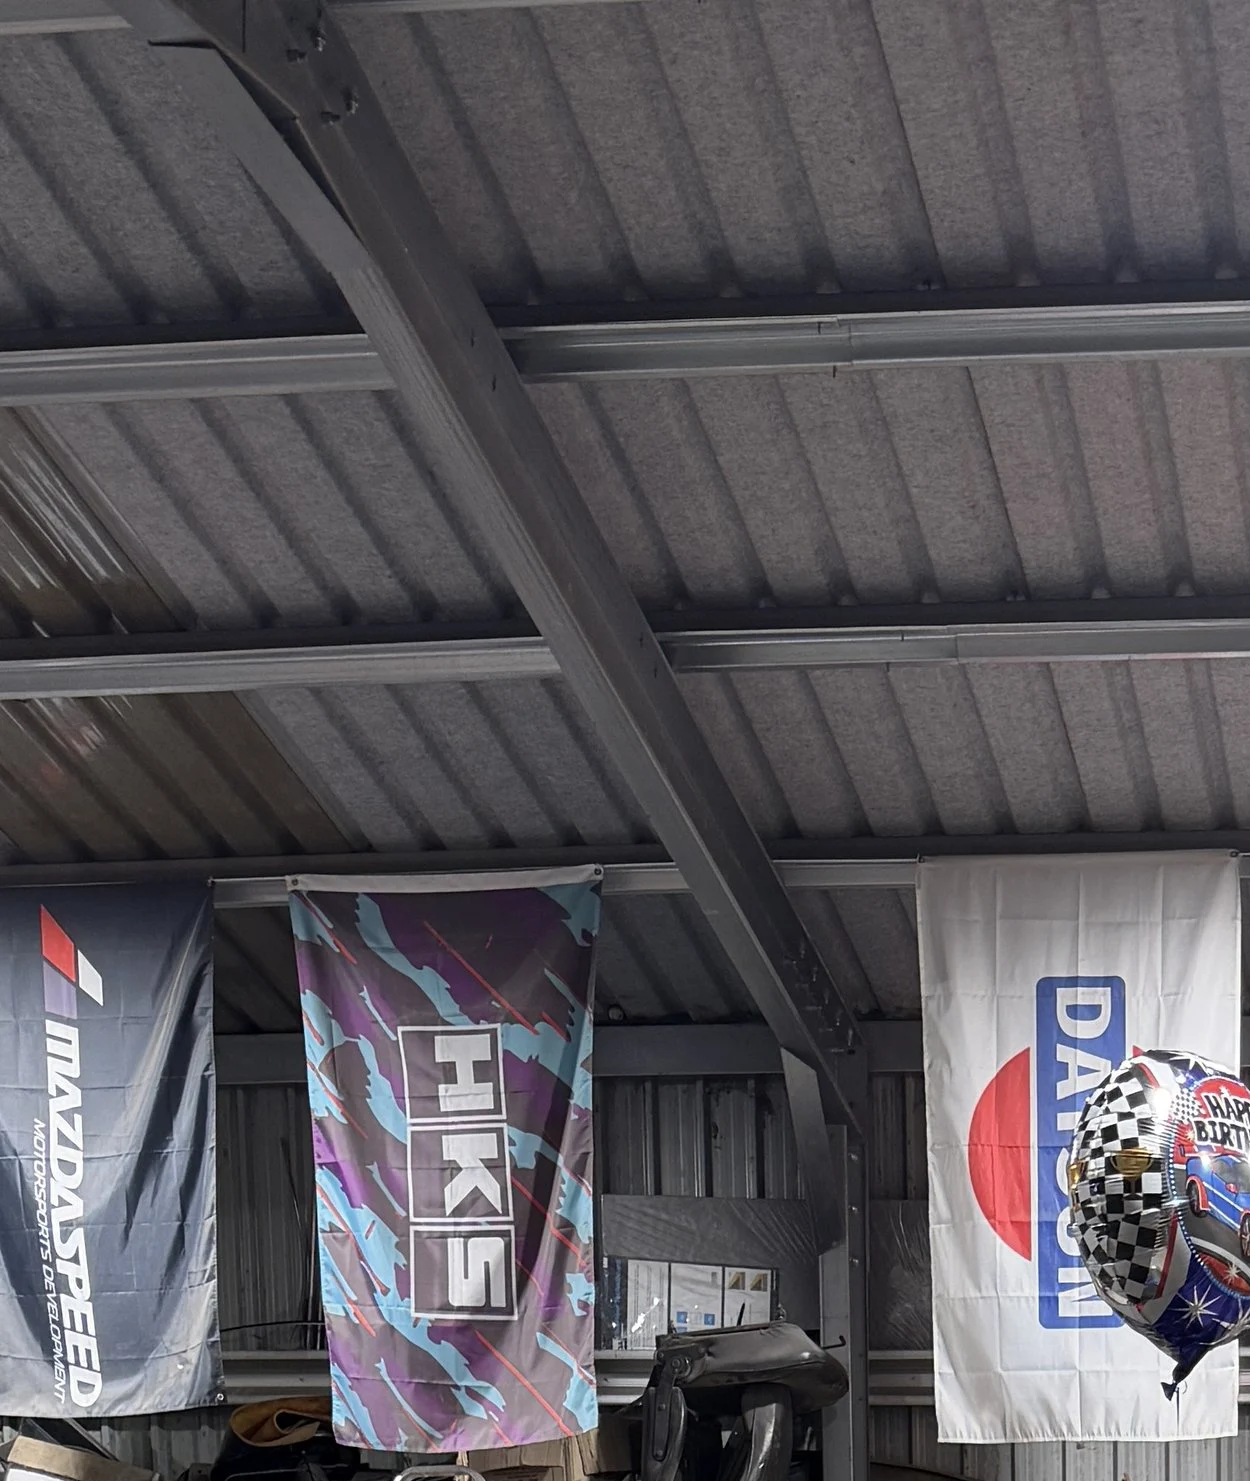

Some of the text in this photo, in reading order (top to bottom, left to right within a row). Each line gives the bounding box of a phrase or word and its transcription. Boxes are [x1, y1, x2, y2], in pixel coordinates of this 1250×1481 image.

[33, 1118, 66, 1404] MOTORSPORTS DEVELOPMENT
[45, 1019, 103, 1408] MAZDASPEED
[434, 1033, 507, 1309] HKS
